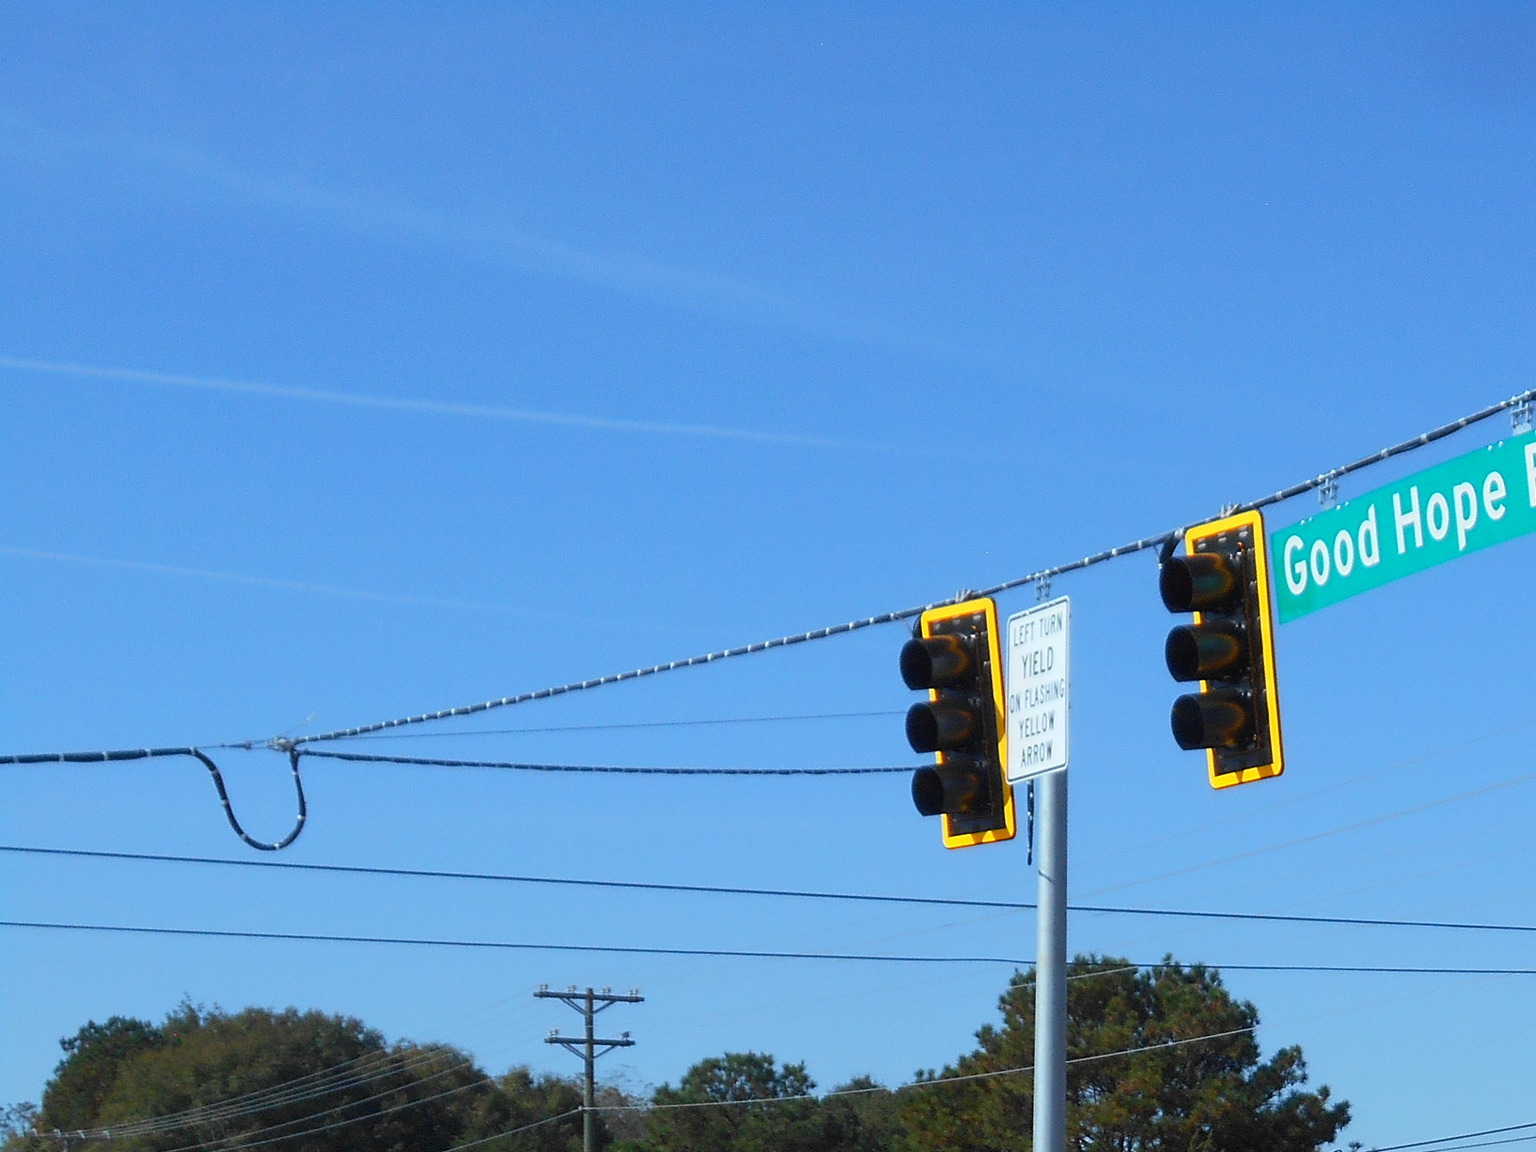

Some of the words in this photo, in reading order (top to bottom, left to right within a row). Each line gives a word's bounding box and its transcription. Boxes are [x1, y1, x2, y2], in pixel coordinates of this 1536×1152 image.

[1284, 503, 1380, 595] Good
[1393, 470, 1507, 553] Hope
[1013, 621, 1035, 646] LEFT
[1039, 611, 1063, 636] TURN
[1021, 646, 1054, 679] YIELD
[1009, 692, 1021, 714] ON
[1024, 678, 1065, 706] FLASHING
[1018, 710, 1056, 739] YELLOW
[1020, 740, 1053, 768] ARROW
